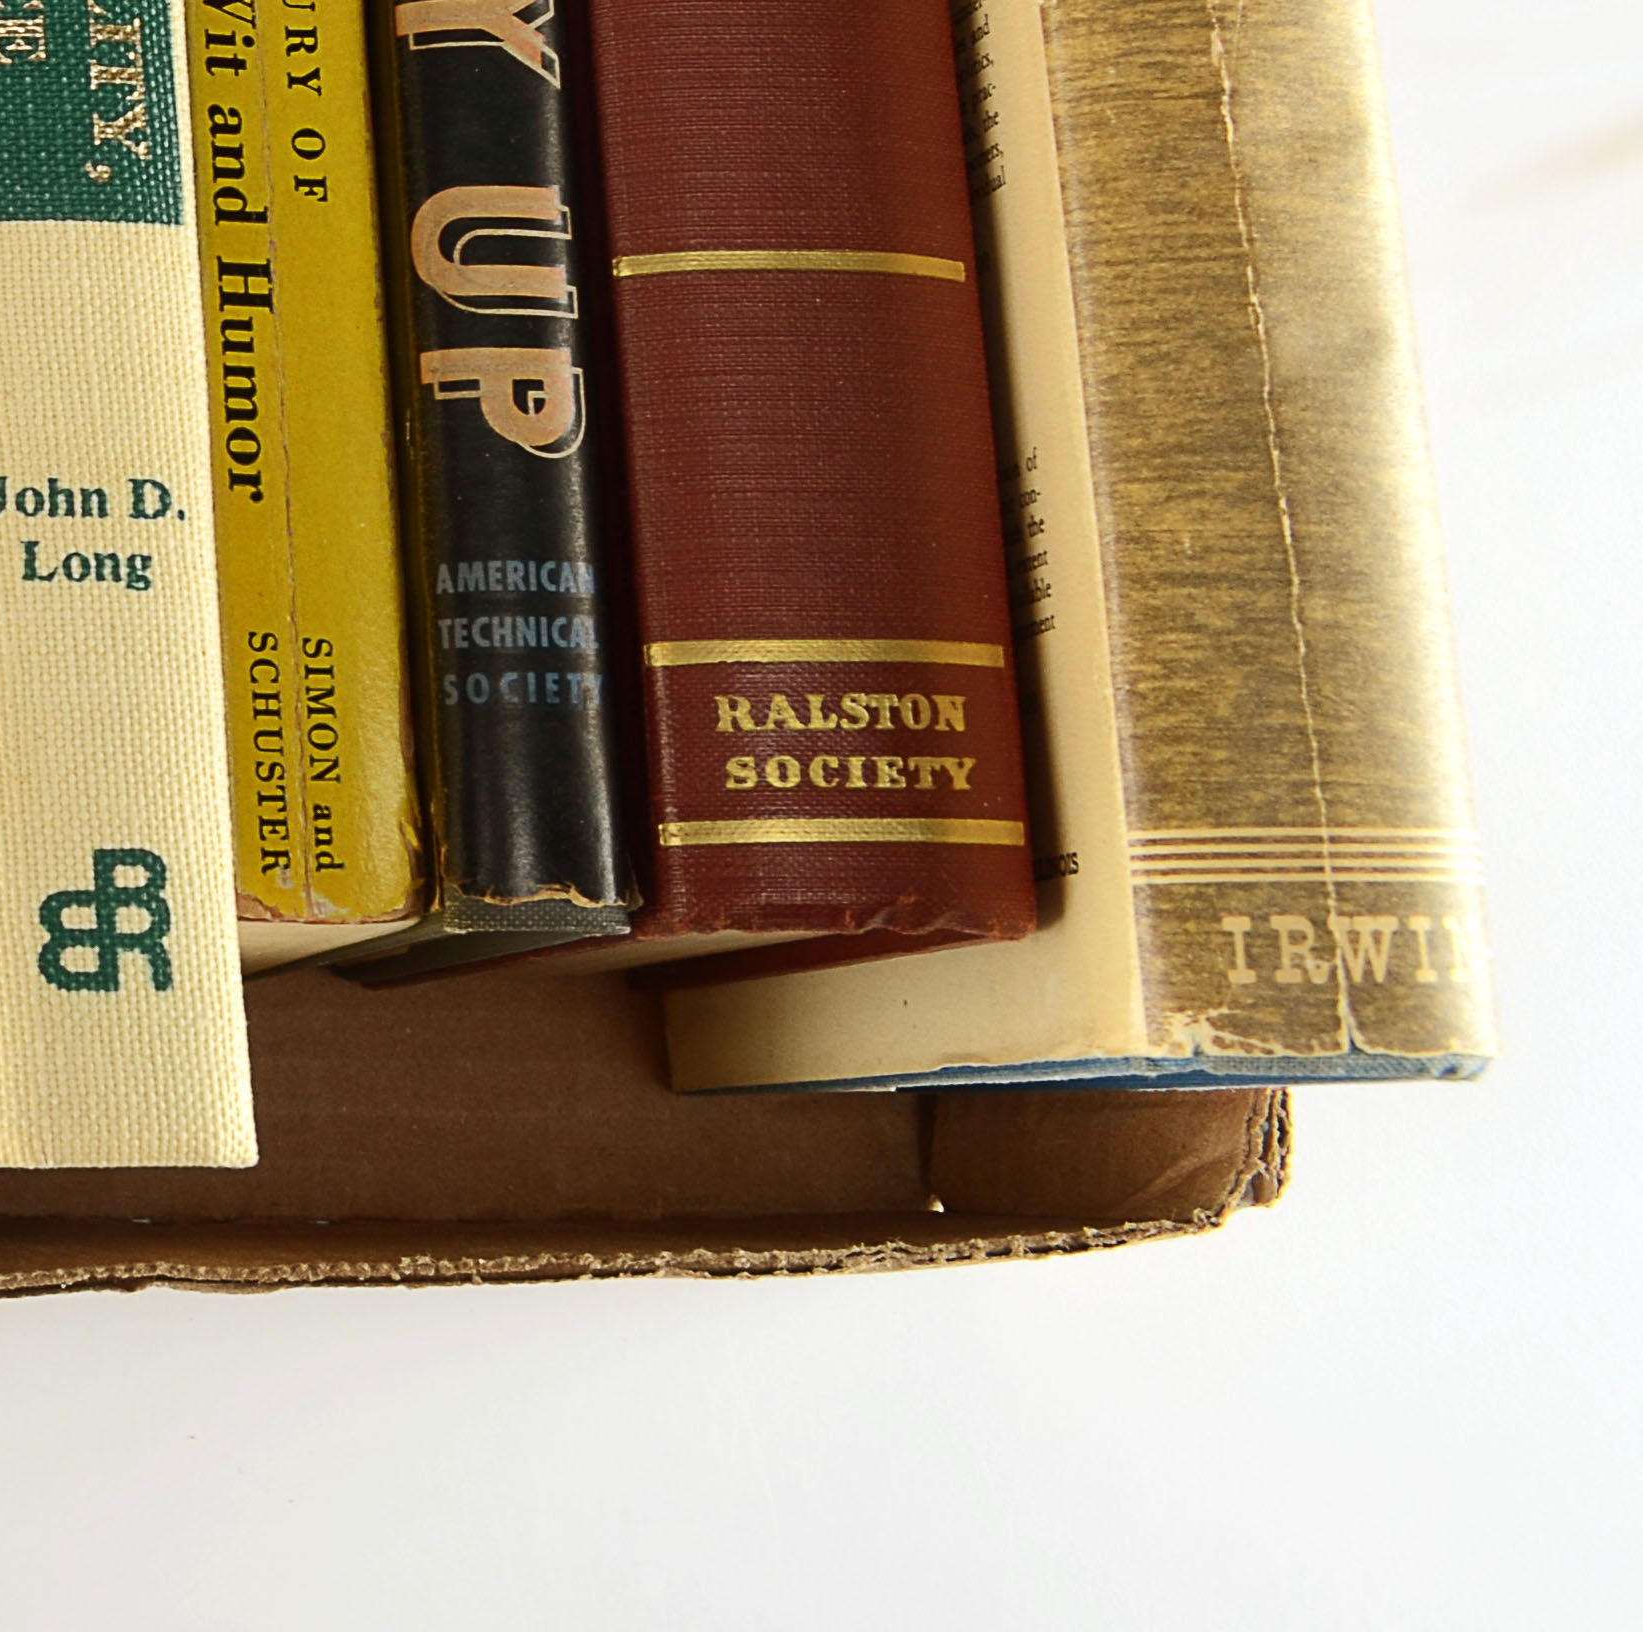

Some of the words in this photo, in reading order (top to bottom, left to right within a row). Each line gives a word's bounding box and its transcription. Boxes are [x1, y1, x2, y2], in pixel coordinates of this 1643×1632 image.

[207, 102, 270, 227] and
[290, 126, 330, 204] OF
[410, 184, 588, 461] UP
[216, 254, 276, 505] Humor
[127, 477, 186, 522] D.
[20, 539, 153, 592] Long
[436, 559, 596, 596] AMERICAN
[436, 616, 600, 650] TECHNICAL
[301, 637, 342, 785] SIMON
[442, 671, 604, 706] SOCIETY
[714, 692, 967, 733] RALSTON
[247, 630, 292, 876] SCHUSTER
[724, 754, 977, 791] SOCIETY
[312, 803, 347, 873] and
